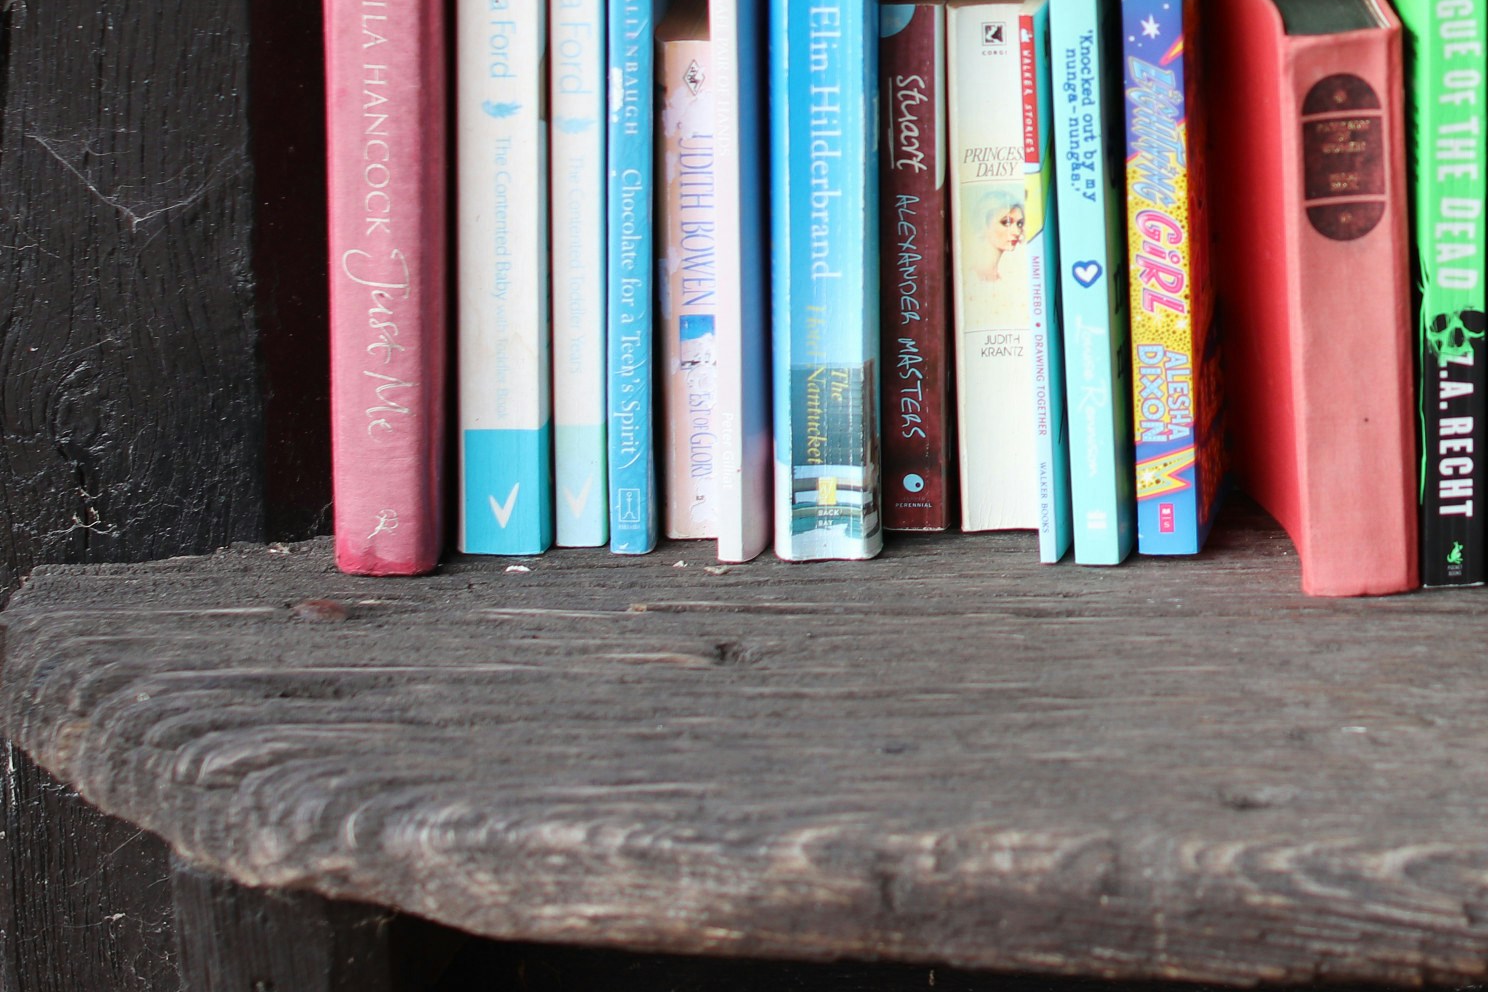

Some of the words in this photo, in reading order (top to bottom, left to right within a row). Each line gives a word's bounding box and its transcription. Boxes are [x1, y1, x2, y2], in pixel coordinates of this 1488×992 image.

[489, 20, 518, 79] Ford
[557, 20, 595, 95] Ford
[808, 6, 842, 73] Elin
[1079, 29, 1096, 107] 'Knocked
[1022, 49, 1034, 96] WALKER
[1438, 69, 1482, 106] OF
[362, 63, 391, 236] HANCOCK
[896, 73, 929, 173] Stuart
[1025, 104, 1036, 154] STORIES
[1082, 112, 1097, 143] out
[1435, 117, 1479, 182] THE
[808, 83, 843, 280] Hilderbrand
[963, 146, 1025, 164] PRINCES
[975, 161, 1018, 178] DAISY
[1082, 149, 1098, 171] by
[619, 169, 643, 269] Chocolate
[1083, 180, 1097, 203] my
[679, 221, 717, 308] BOWEN
[895, 193, 923, 326] ALEXANDER
[1032, 255, 1041, 281] MIMI
[1434, 197, 1482, 291] DEAD
[341, 248, 412, 364] Just
[620, 276, 643, 307] for
[621, 312, 637, 324] a
[1033, 284, 1043, 316] THEBO
[619, 331, 643, 393] Teen's
[980, 345, 1024, 358] KRANTZ
[984, 333, 1020, 346] JUDITH
[1034, 334, 1045, 381] DRAWING
[362, 370, 421, 439] Me
[829, 367, 849, 401] The
[896, 338, 927, 439] MASTERS
[1137, 344, 1169, 443] DIXON
[1164, 350, 1193, 441] ALESHA
[1439, 351, 1475, 410] Z.A.
[613, 399, 643, 456] Spirit
[721, 412, 736, 445] Peter
[1036, 385, 1048, 436] TOGETHER
[1438, 416, 1475, 518] RECHT
